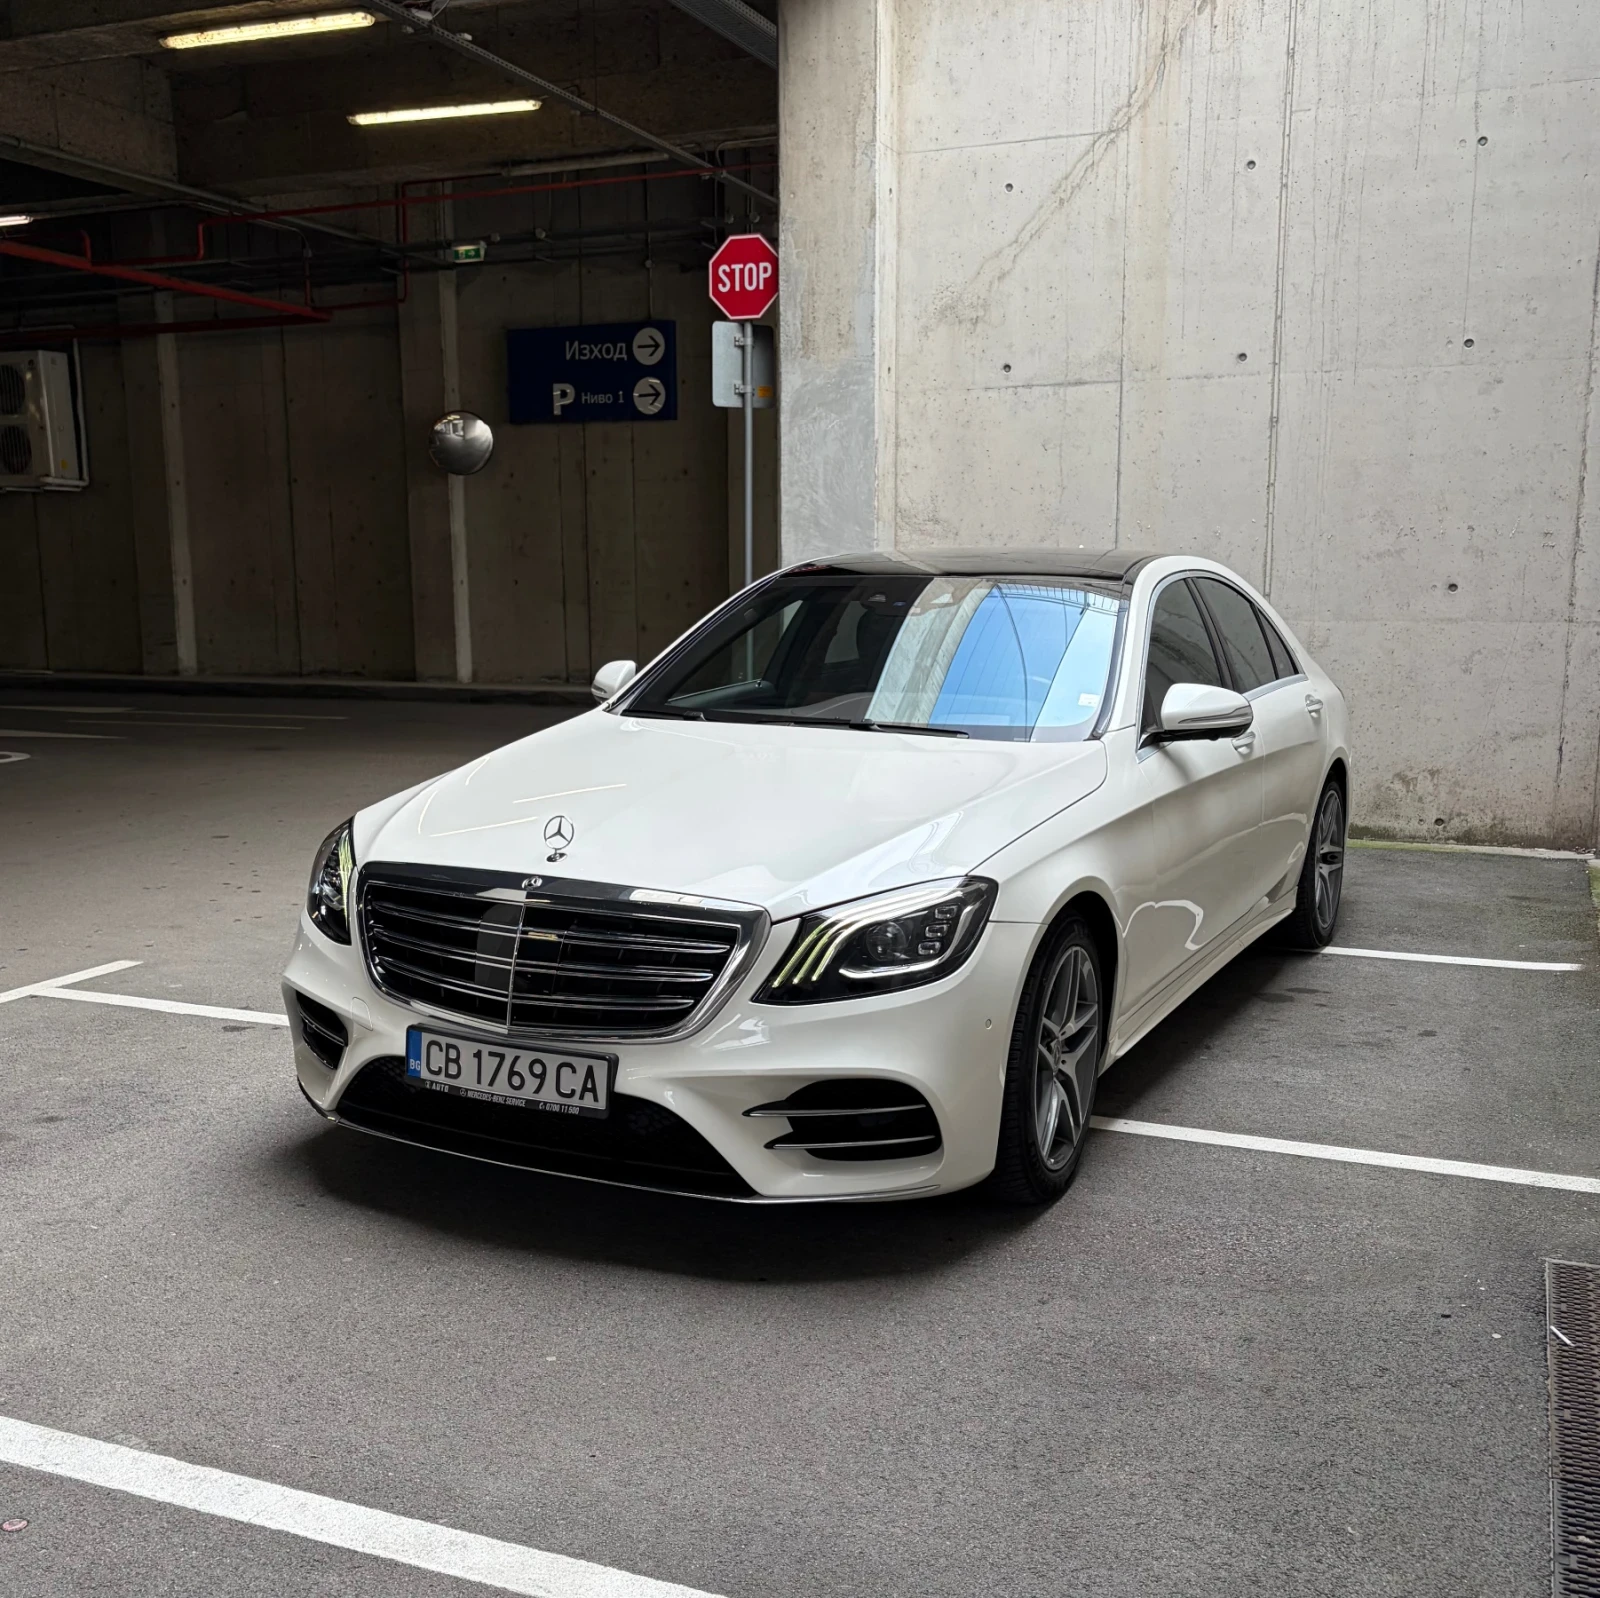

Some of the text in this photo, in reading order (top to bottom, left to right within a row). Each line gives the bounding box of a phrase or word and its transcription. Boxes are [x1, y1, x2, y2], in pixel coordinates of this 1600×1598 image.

[718, 262, 772, 292] STOP
[565, 341, 628, 361] Изход
[552, 383, 625, 415] P Ниво 1
[409, 1058, 421, 1071] BG
[425, 1040, 599, 1103] CB 1769 CA
[431, 1082, 449, 1093] AUTO
[467, 1090, 526, 1107] MERCEDES-BENZ SERVICE
